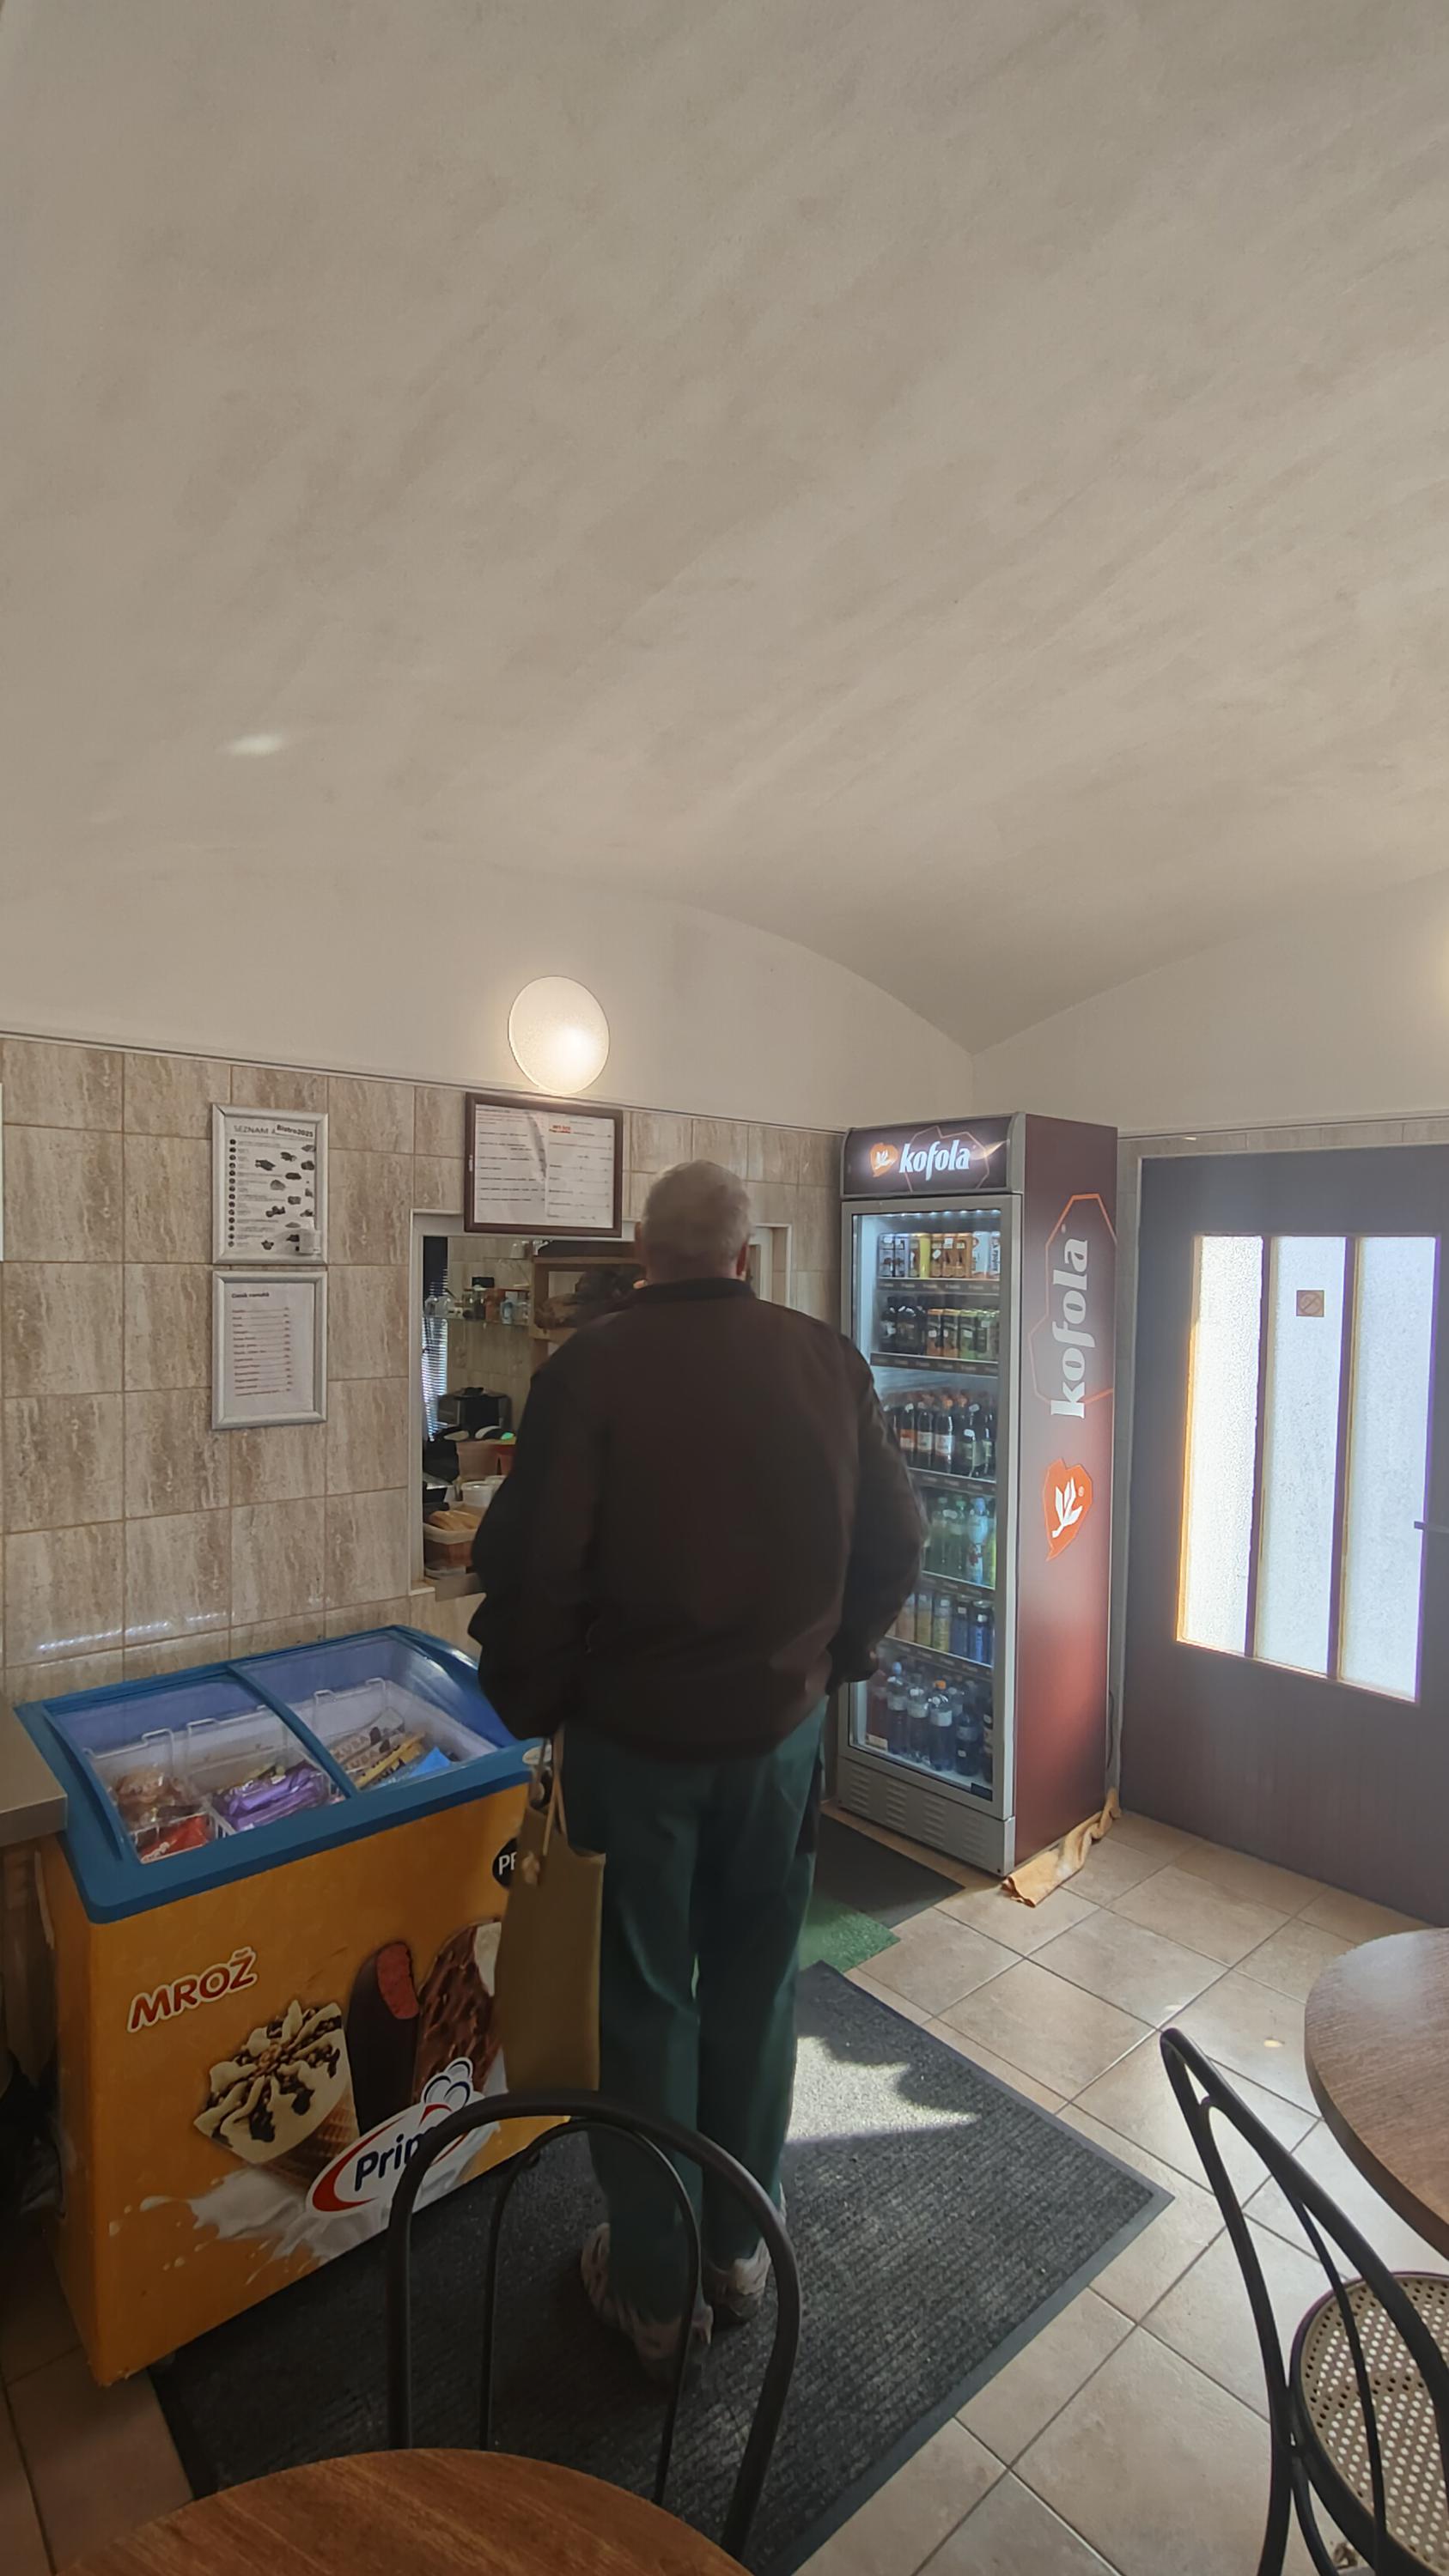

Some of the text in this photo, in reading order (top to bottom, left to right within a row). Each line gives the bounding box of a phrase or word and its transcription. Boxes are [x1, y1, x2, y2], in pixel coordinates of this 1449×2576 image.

[898, 1139, 971, 1182] kofola
[1050, 1237, 1097, 1419] kofola
[129, 1947, 258, 2032] MROŽ
